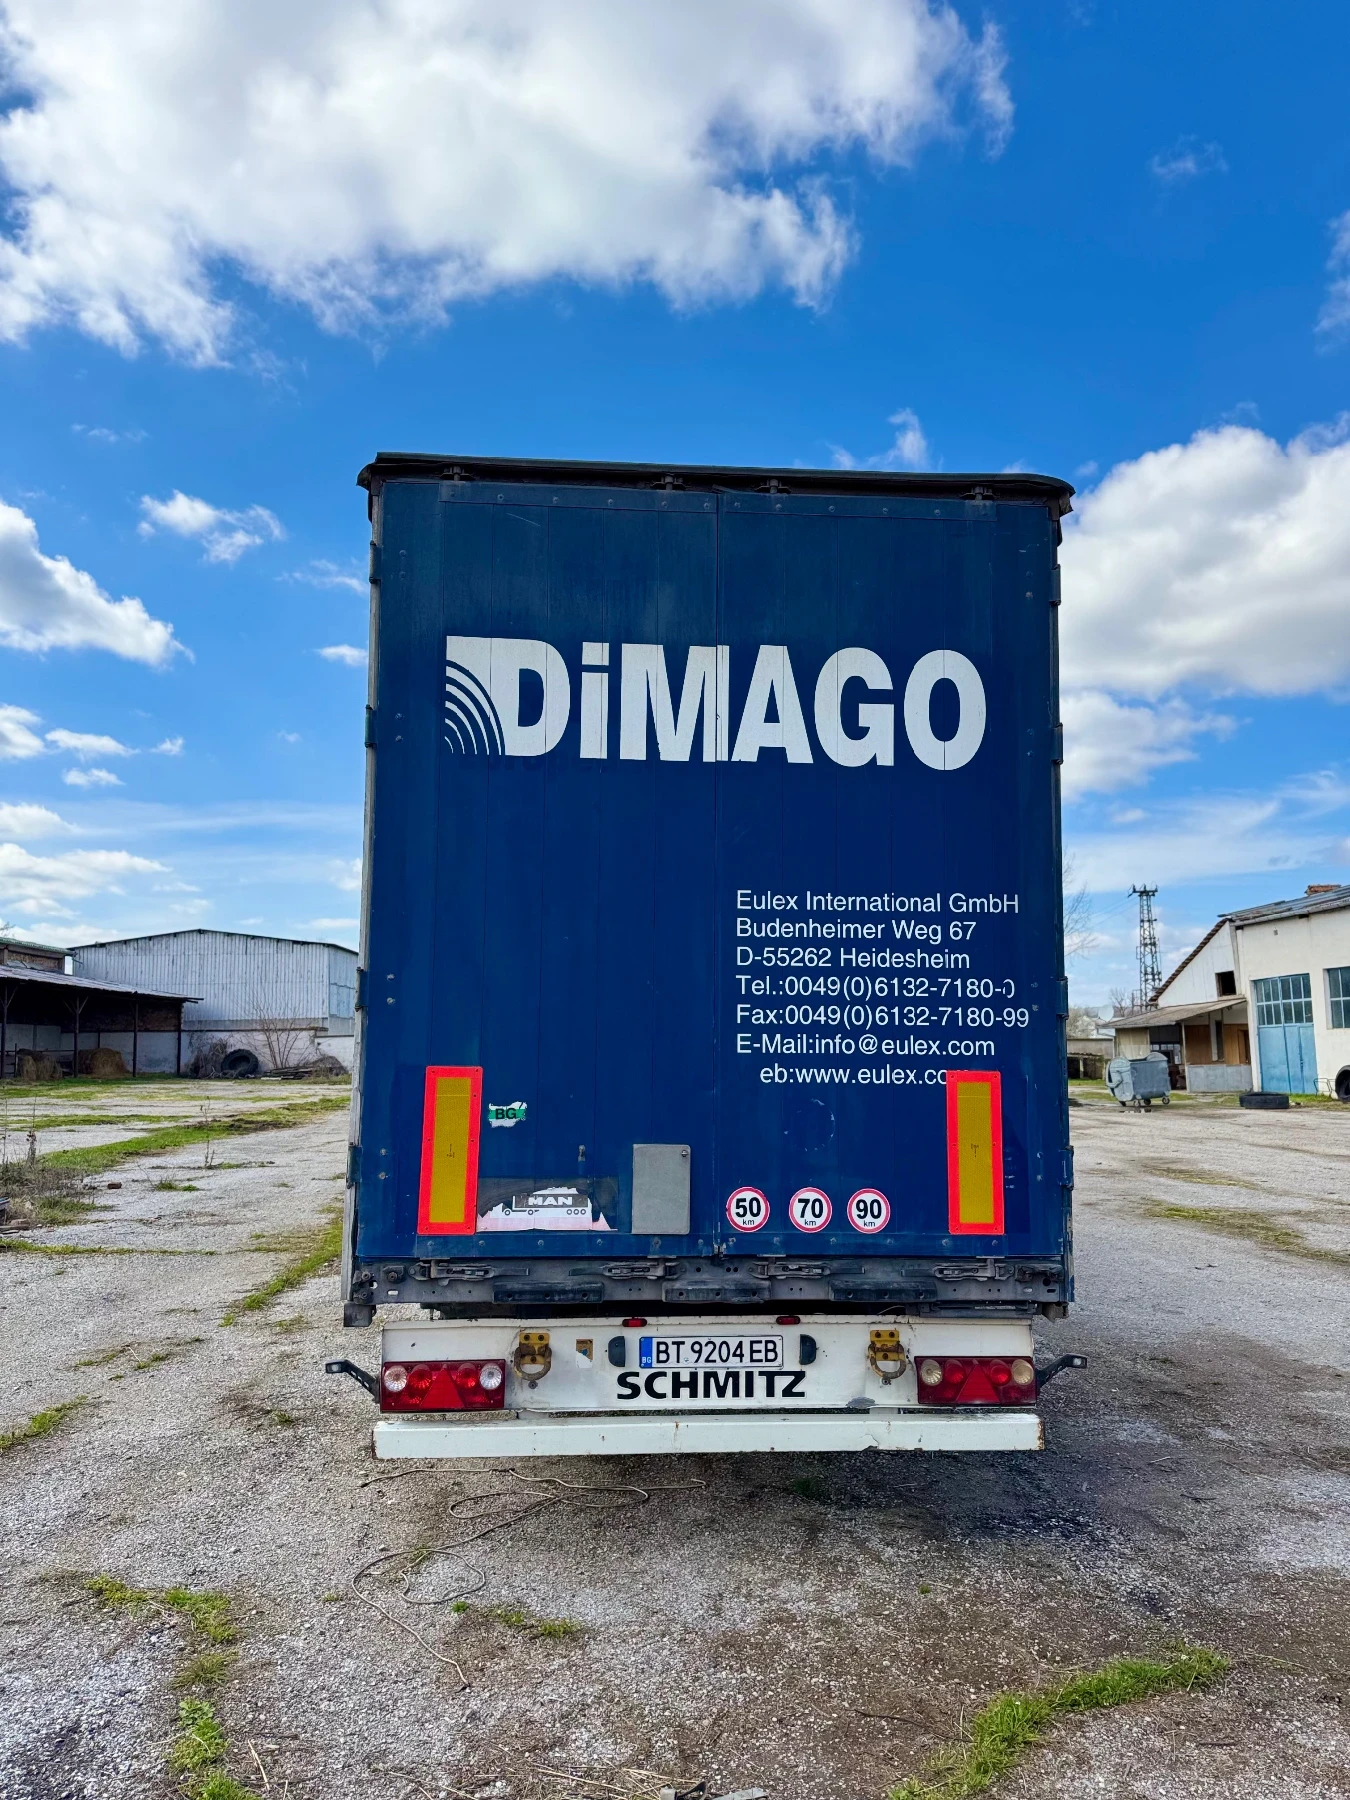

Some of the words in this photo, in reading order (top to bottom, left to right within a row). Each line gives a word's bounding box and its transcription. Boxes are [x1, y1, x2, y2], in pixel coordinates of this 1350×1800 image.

[446, 636, 986, 770] DiMAGO
[736, 889, 799, 910] Eulex
[806, 890, 941, 912] International
[948, 892, 1020, 914] GmbH
[736, 918, 886, 939] Budenheimer
[891, 919, 942, 945] Weg
[949, 921, 977, 941] 67
[736, 946, 832, 967] D-55262
[840, 947, 970, 969] Heidesheim
[760, 1063, 969, 1085] eb:www.eulex.co
[495, 1107, 517, 1120] BG
[528, 1196, 573, 1206] MAN
[735, 1197, 762, 1218] 50
[797, 1198, 824, 1219] 70
[855, 1199, 882, 1220] 90
[742, 1217, 755, 1226] km
[804, 1218, 817, 1227] km
[863, 1219, 876, 1228] km
[641, 1356, 652, 1364] BG
[616, 1370, 806, 1400] SCHMITZ
